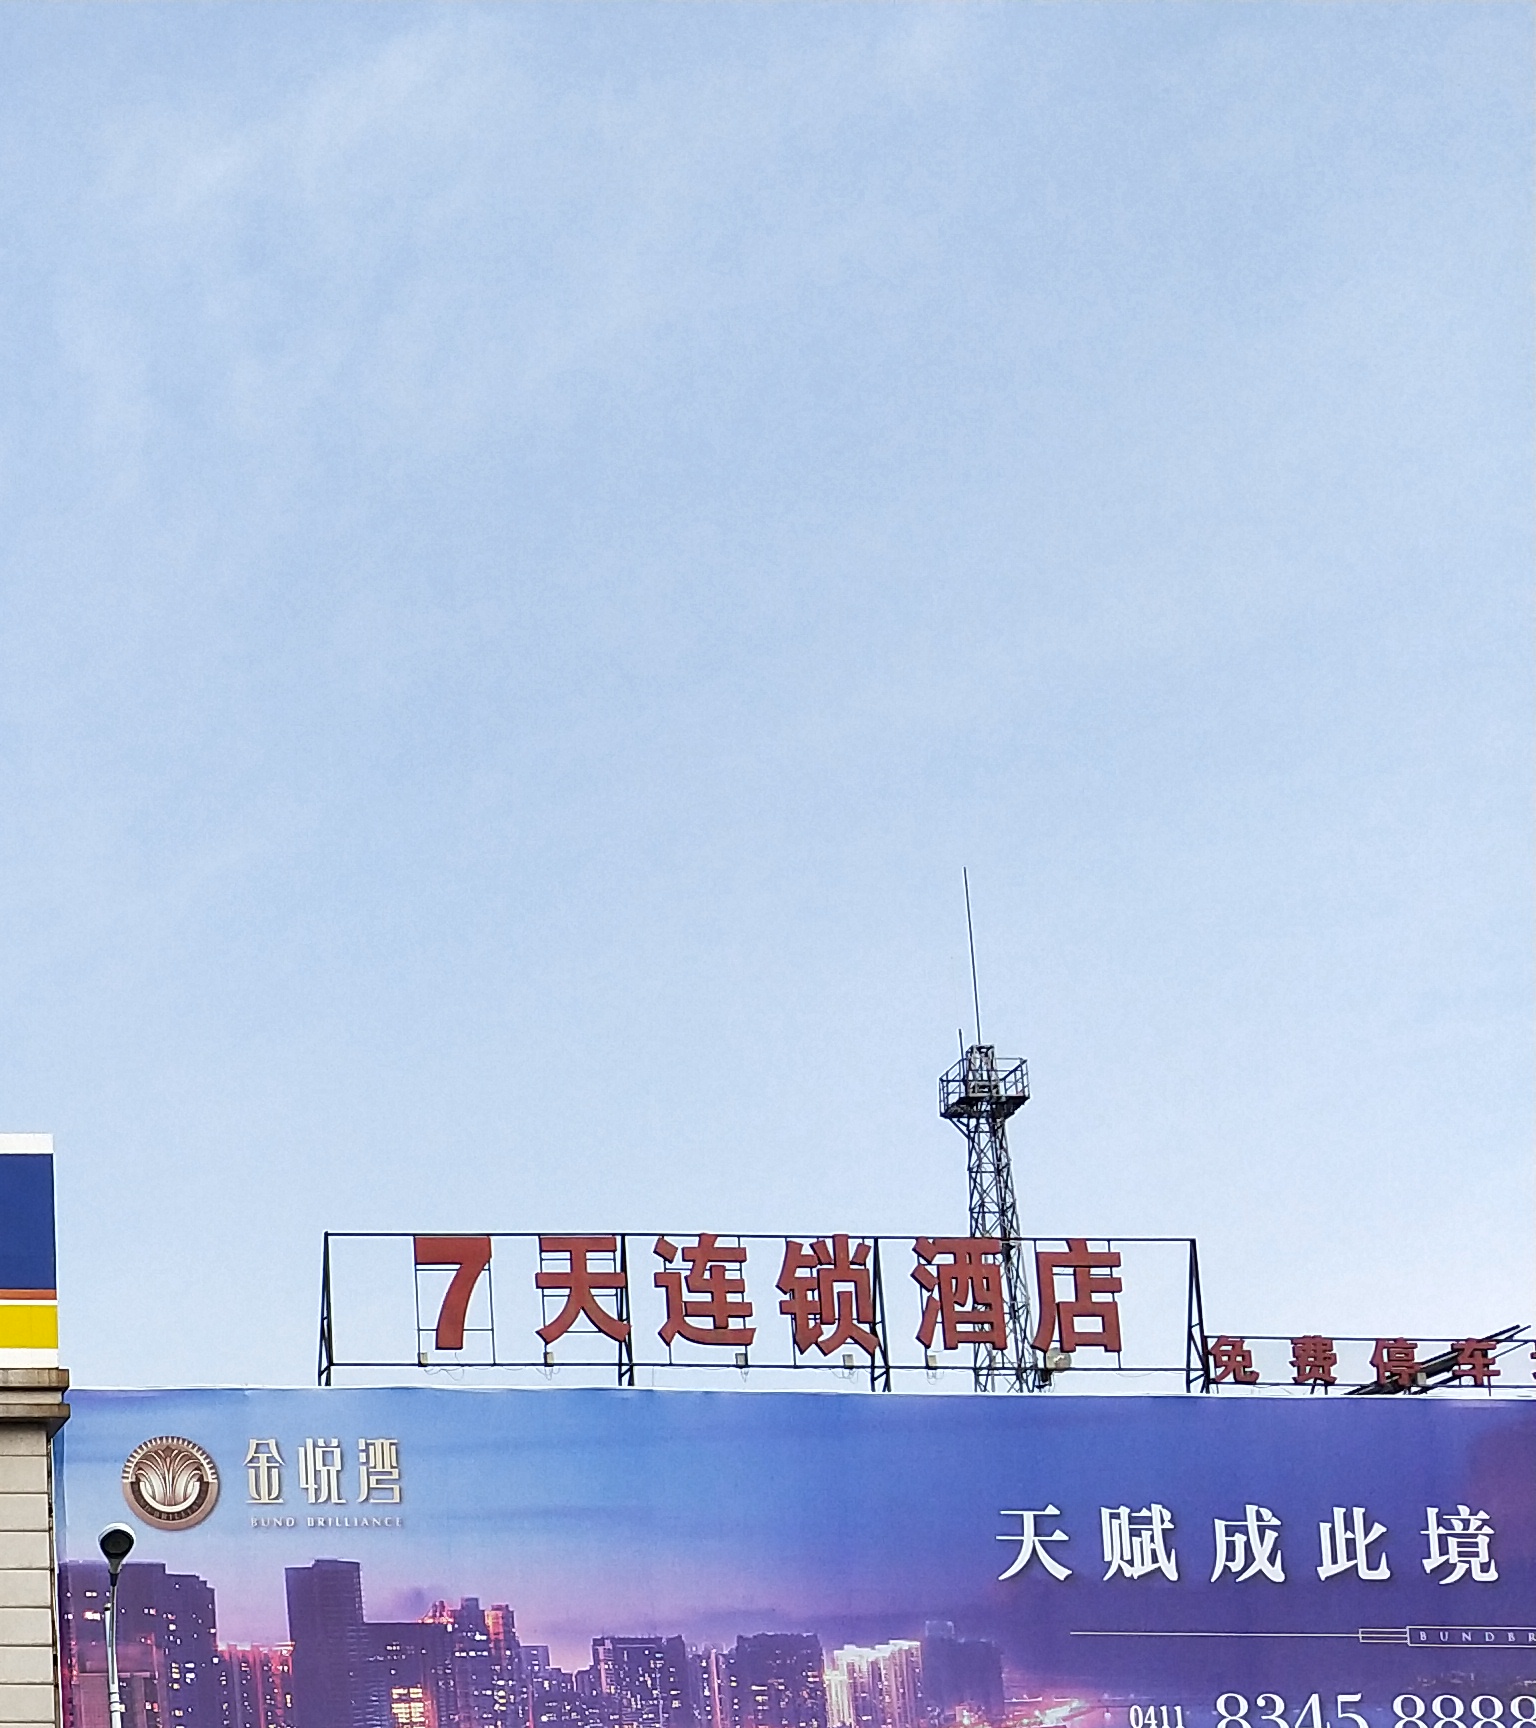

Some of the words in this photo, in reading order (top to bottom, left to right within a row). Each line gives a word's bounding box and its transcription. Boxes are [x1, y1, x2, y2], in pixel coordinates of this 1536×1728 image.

[413, 1233, 1125, 1356] 7天连锁酒店
[1209, 1334, 1536, 1386] 免费停车
[243, 1437, 402, 1504] 金悦湾
[250, 1516, 295, 1528] BUND
[996, 1506, 1499, 1586] 天赋成此境
